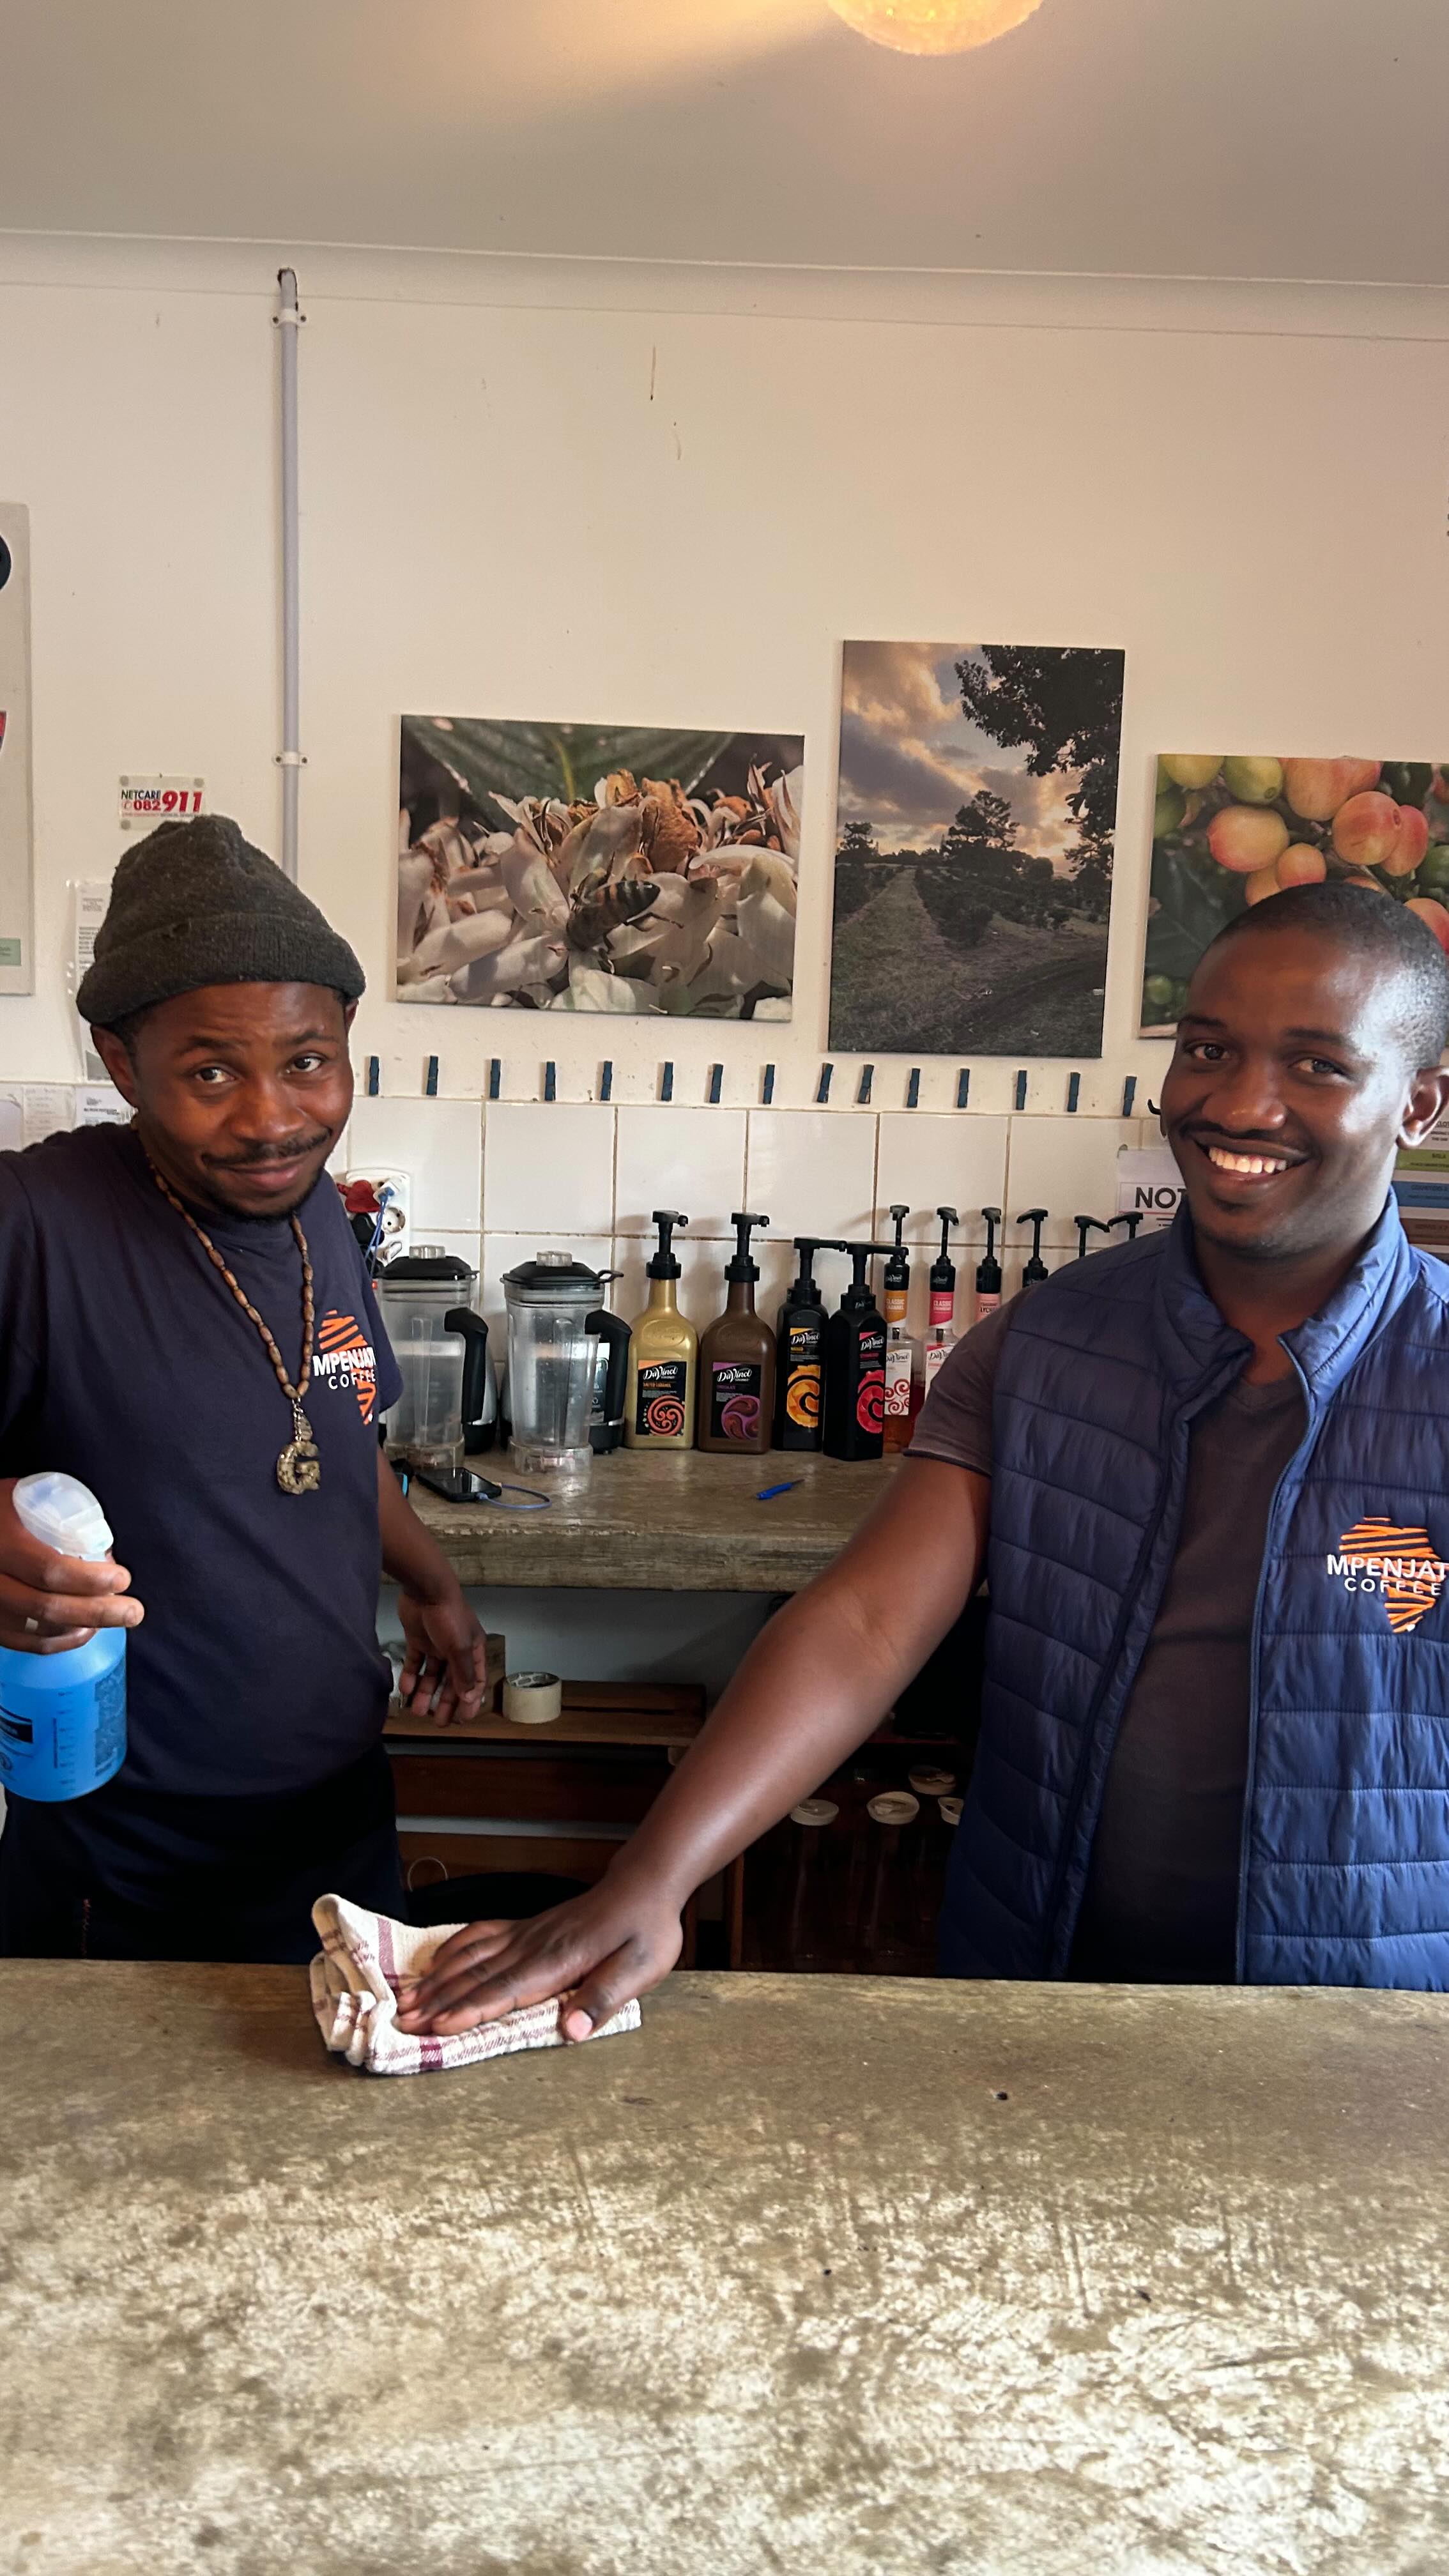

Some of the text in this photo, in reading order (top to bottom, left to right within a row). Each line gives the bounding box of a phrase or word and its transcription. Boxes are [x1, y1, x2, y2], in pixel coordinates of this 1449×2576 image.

[121, 790, 161, 799] NETCARE
[134, 790, 203, 813] 082 911
[328, 1369, 376, 1390] COFFEE
[643, 1365, 678, 1380] DaVinci
[717, 1368, 752, 1383] DaVinci
[1327, 1554, 1449, 1581] MPENJAT
[1344, 1577, 1441, 1595] COFFEE
